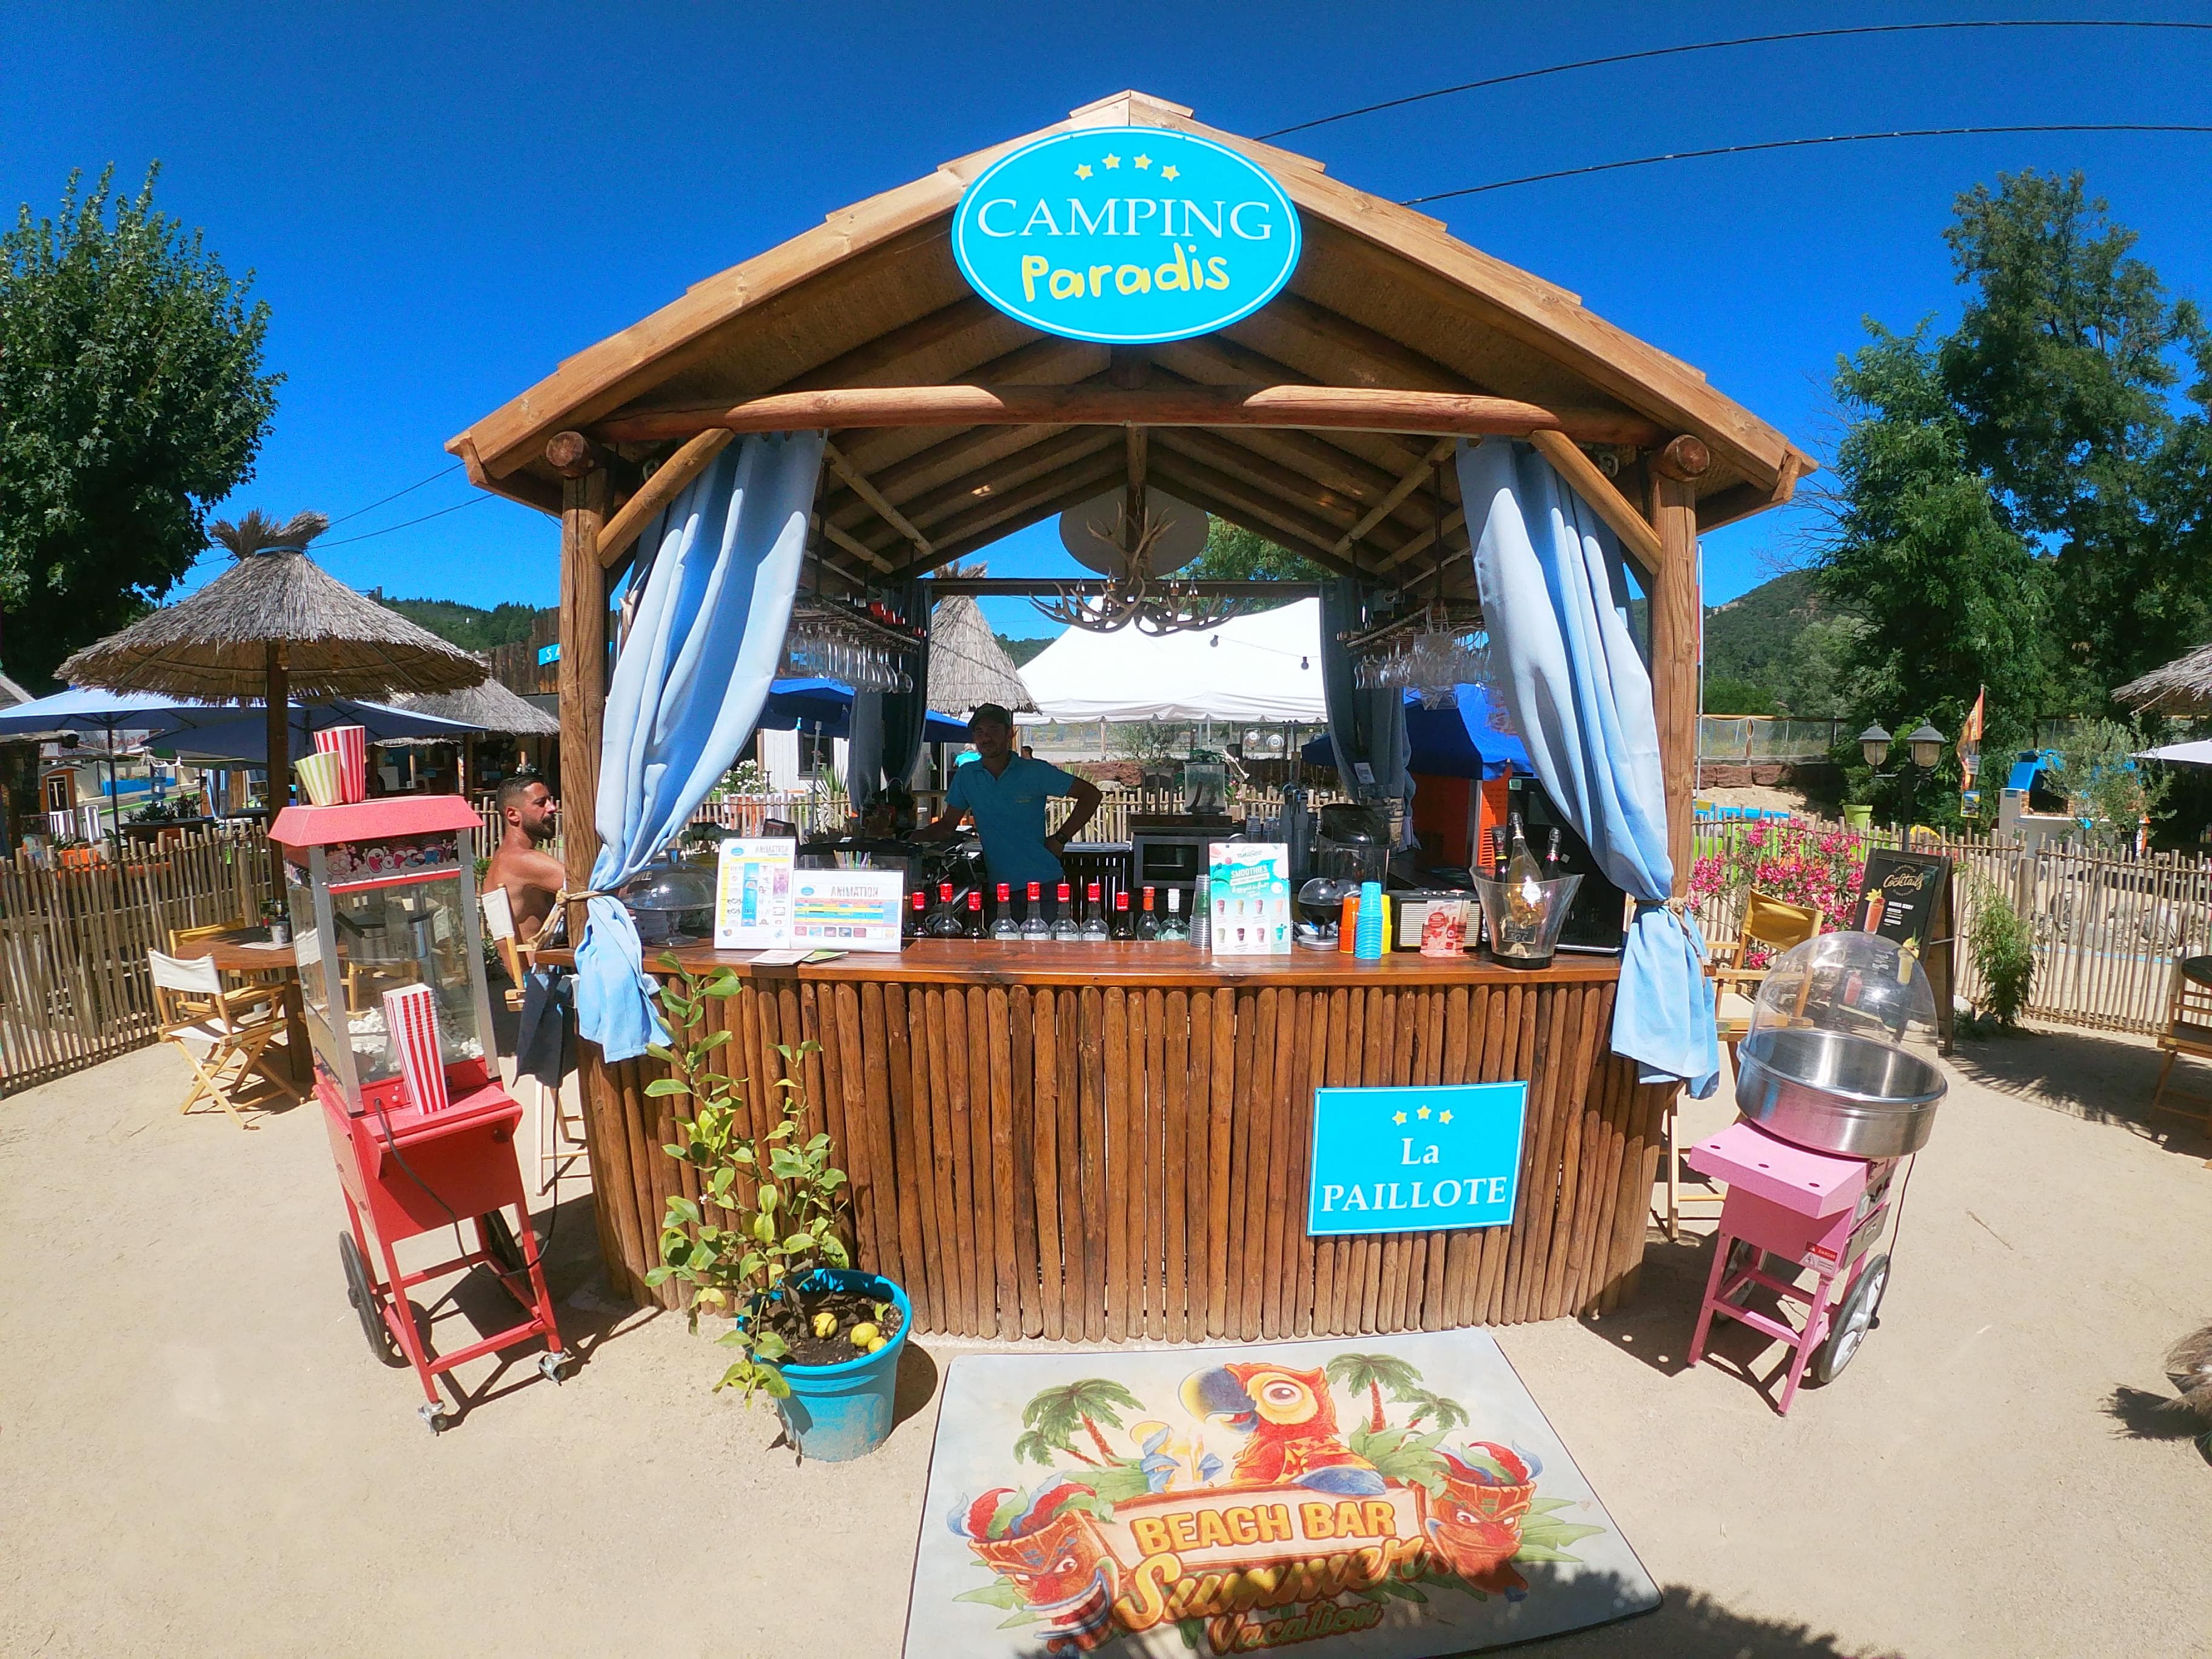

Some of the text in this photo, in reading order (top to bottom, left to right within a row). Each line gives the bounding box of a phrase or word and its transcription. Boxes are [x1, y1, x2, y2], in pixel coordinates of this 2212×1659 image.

[977, 197, 1272, 240] CAMPING
[1021, 243, 1230, 303] Paradis
[831, 886, 879, 897] ANIMATION
[1230, 865, 1268, 879] SMOOTHIES
[1883, 873, 1924, 890] Cocktails
[1401, 1138, 1439, 1165] La
[1321, 1176, 1507, 1212] PAILLOTE
[1130, 1501, 1396, 1557] BEACH BAR
[1112, 1535, 1432, 1631] Summer
[1209, 1600, 1384, 1656] Vacation
